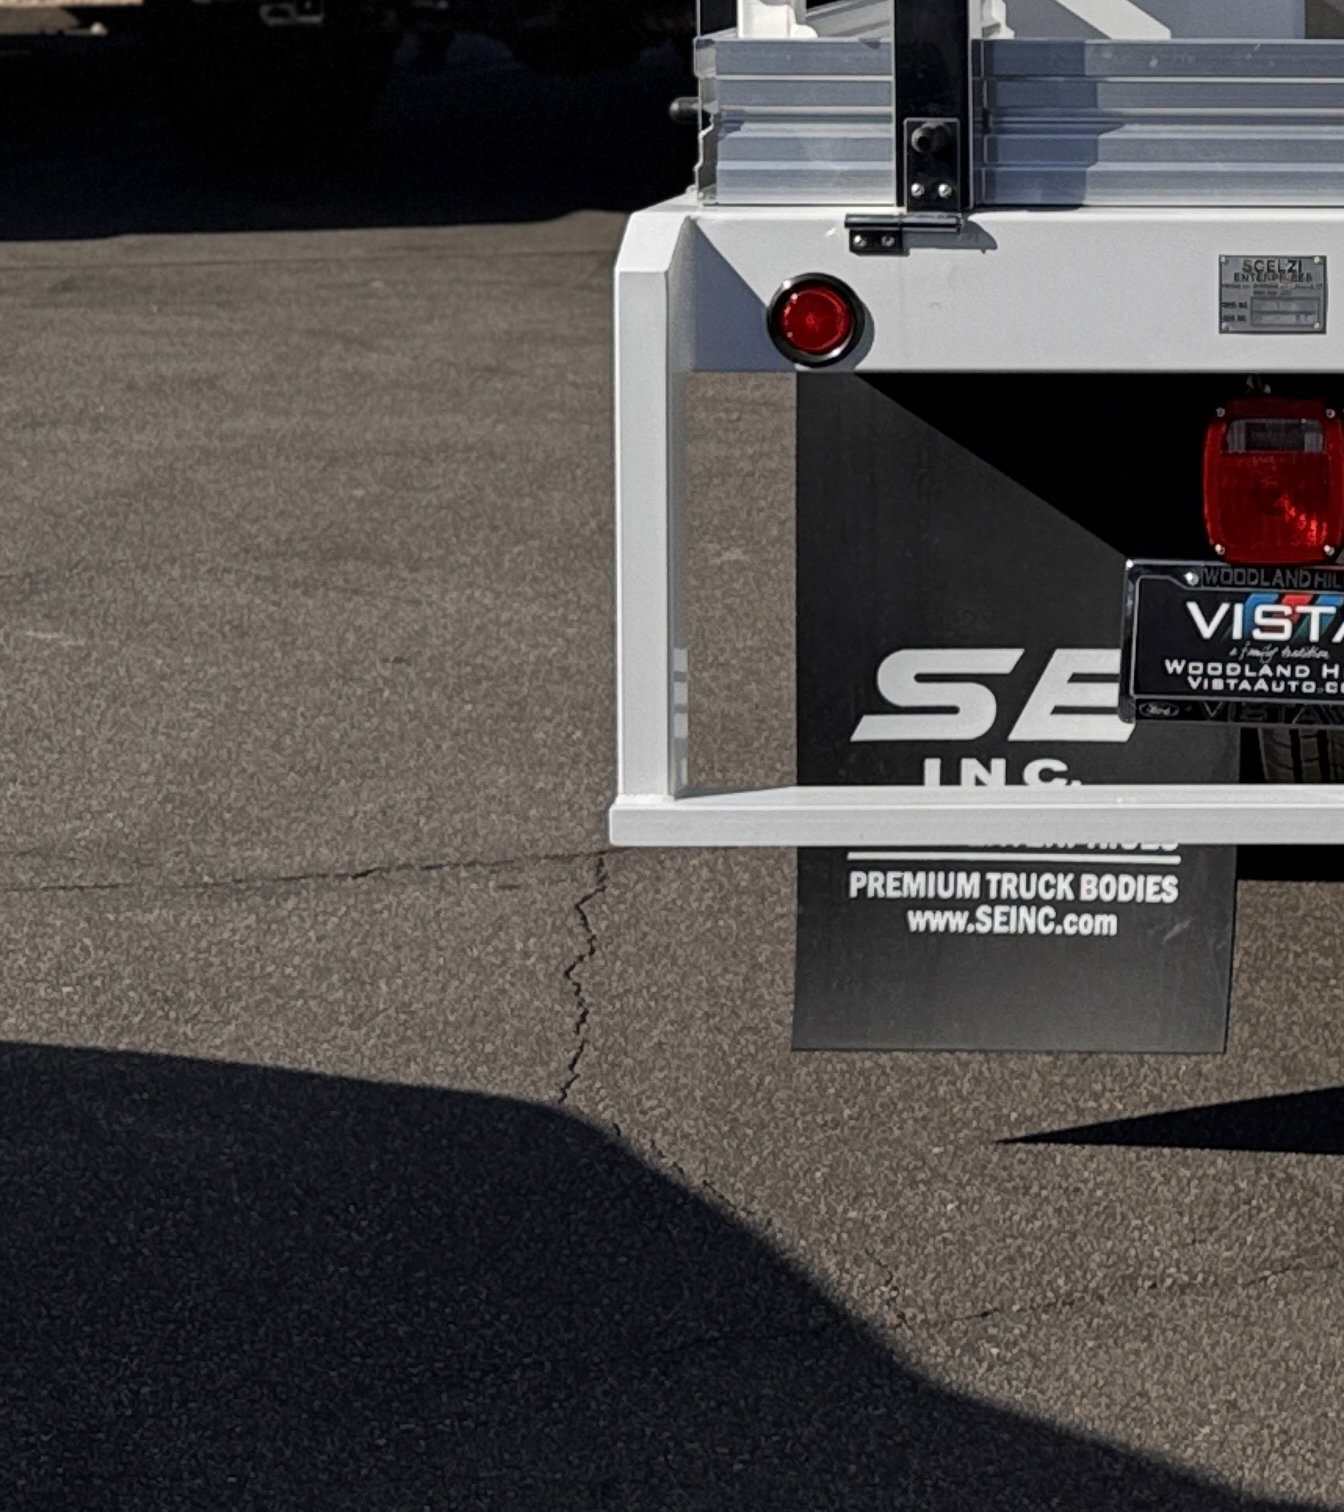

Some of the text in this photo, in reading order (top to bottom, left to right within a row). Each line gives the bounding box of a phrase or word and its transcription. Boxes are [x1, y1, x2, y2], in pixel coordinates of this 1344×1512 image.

[1242, 259, 1303, 273] SCELZI
[1203, 567, 1311, 588] WOODLAND
[1165, 659, 1311, 679] WOODLAND
[850, 648, 1137, 742] SE
[849, 870, 1179, 904] PREMIUM TRUCK BODIES
[907, 904, 1118, 937] www.SEINC.com
